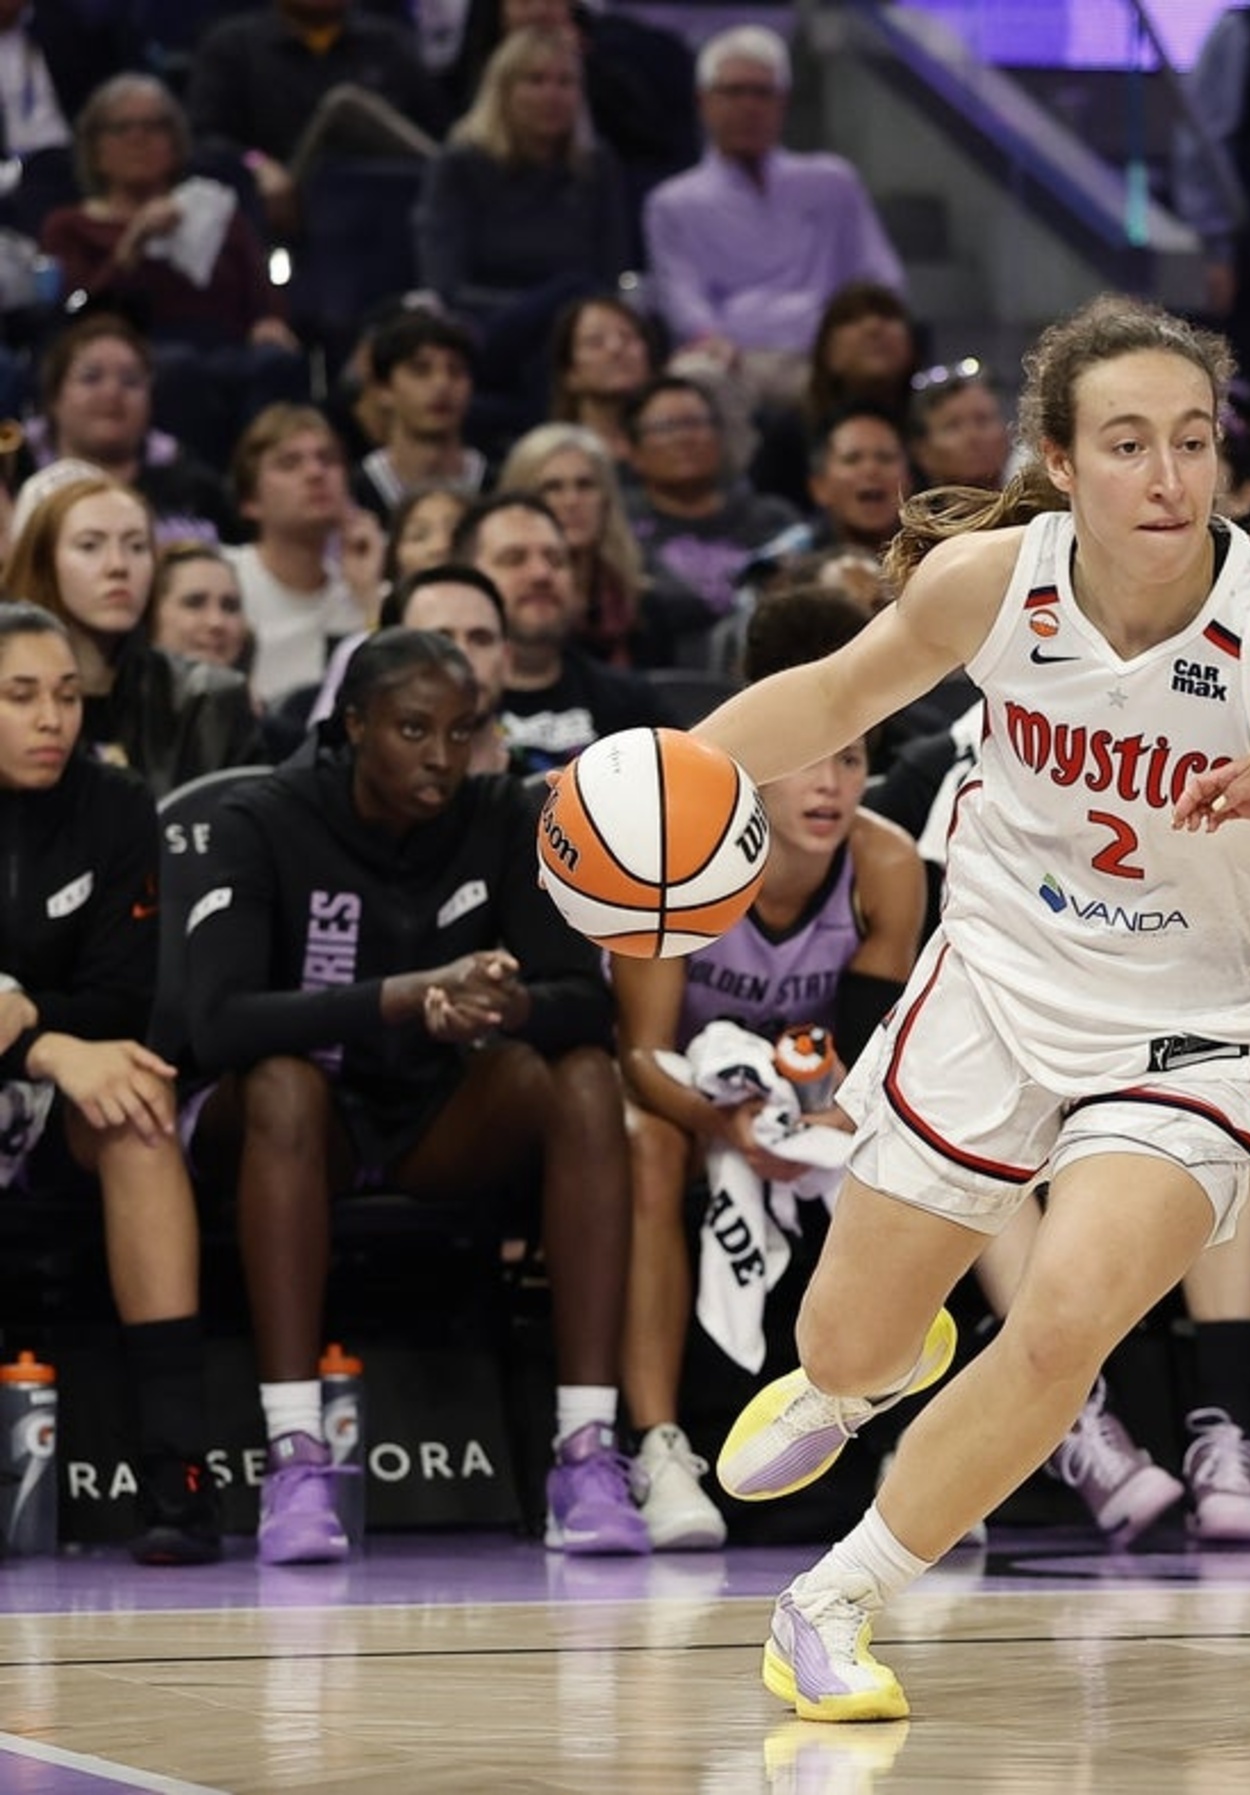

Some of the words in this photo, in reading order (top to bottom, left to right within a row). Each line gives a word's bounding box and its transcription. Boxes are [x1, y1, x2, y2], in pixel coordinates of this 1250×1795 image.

[1171, 675, 1228, 701] max
[1173, 659, 1219, 682] CAR
[1004, 701, 1233, 809] mystic
[1087, 809, 1145, 880] 2
[1071, 895, 1189, 931] VANDA
[302, 890, 362, 990] RIES
[689, 960, 770, 1003] OLDEN
[775, 971, 840, 1005] STAT
